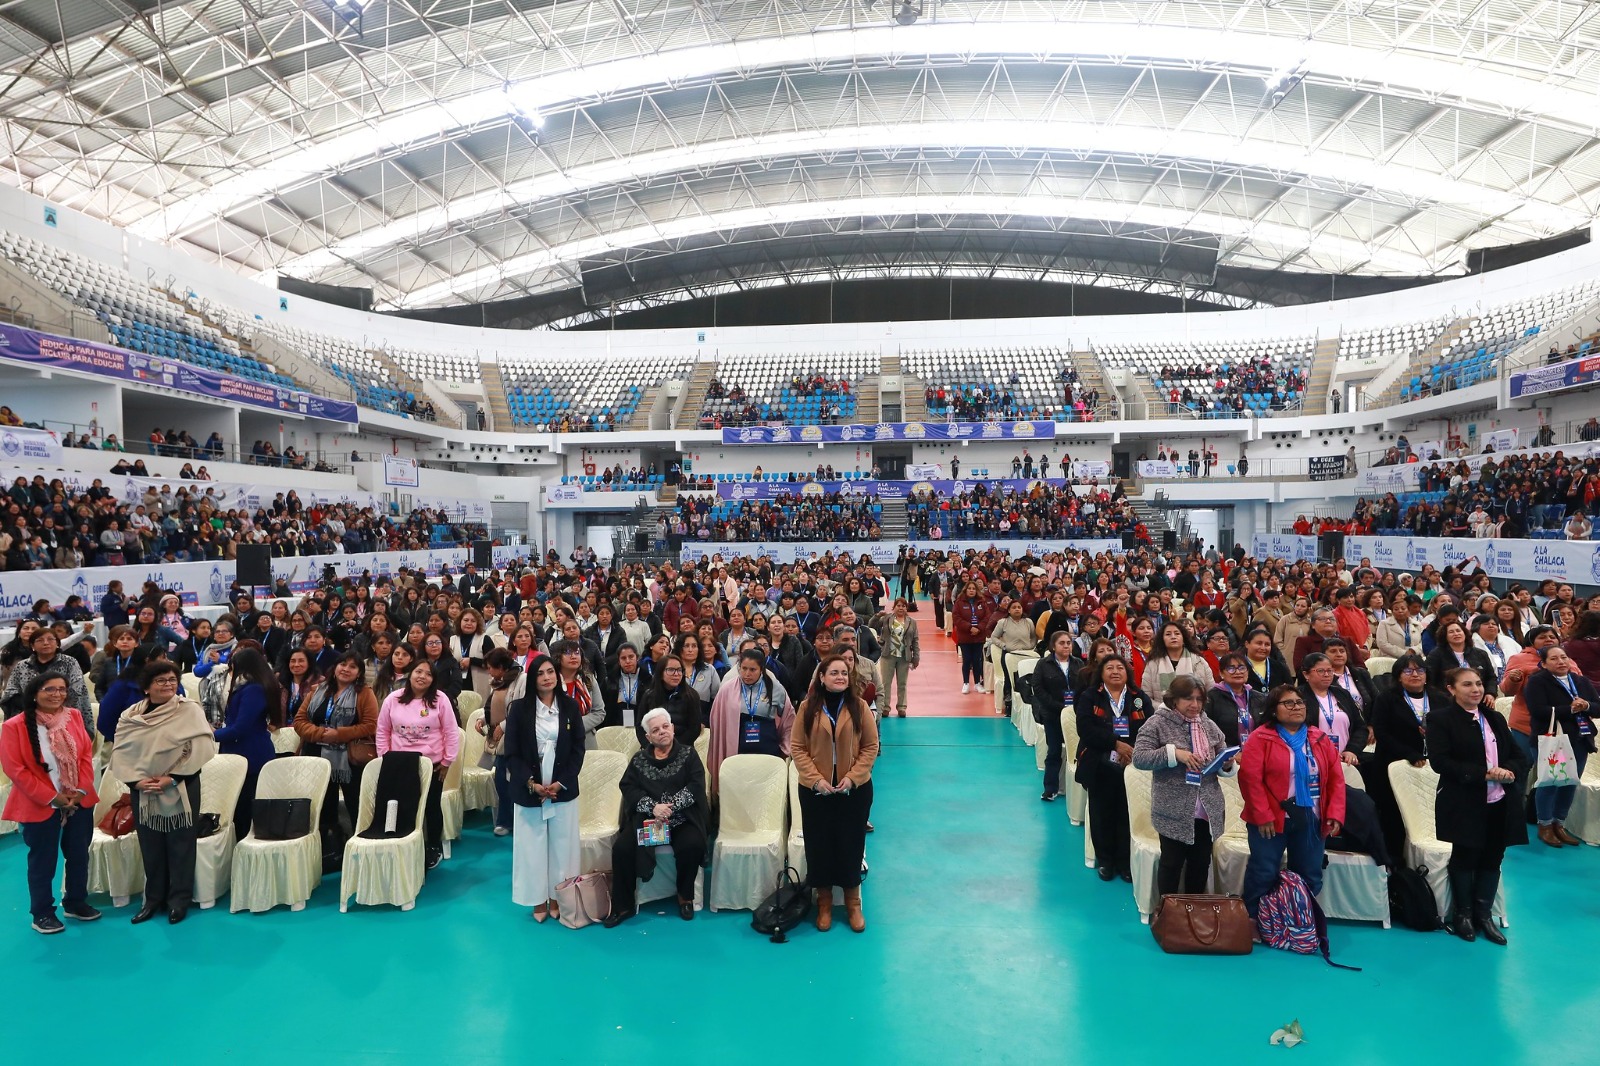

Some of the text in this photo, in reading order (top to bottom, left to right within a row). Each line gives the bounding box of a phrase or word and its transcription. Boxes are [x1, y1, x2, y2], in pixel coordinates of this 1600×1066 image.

[40, 348, 70, 360] INCLUIR
[72, 354, 92, 364] PARA
[76, 346, 95, 356] PARA
[96, 350, 124, 362] INCLUIR
[1533, 546, 1548, 555] A LA
[1444, 552, 1466, 560] CHALACA
[1535, 556, 1565, 566] CHALACA
[154, 573, 164, 582] LA
[0, 594, 33, 608] ALACA
